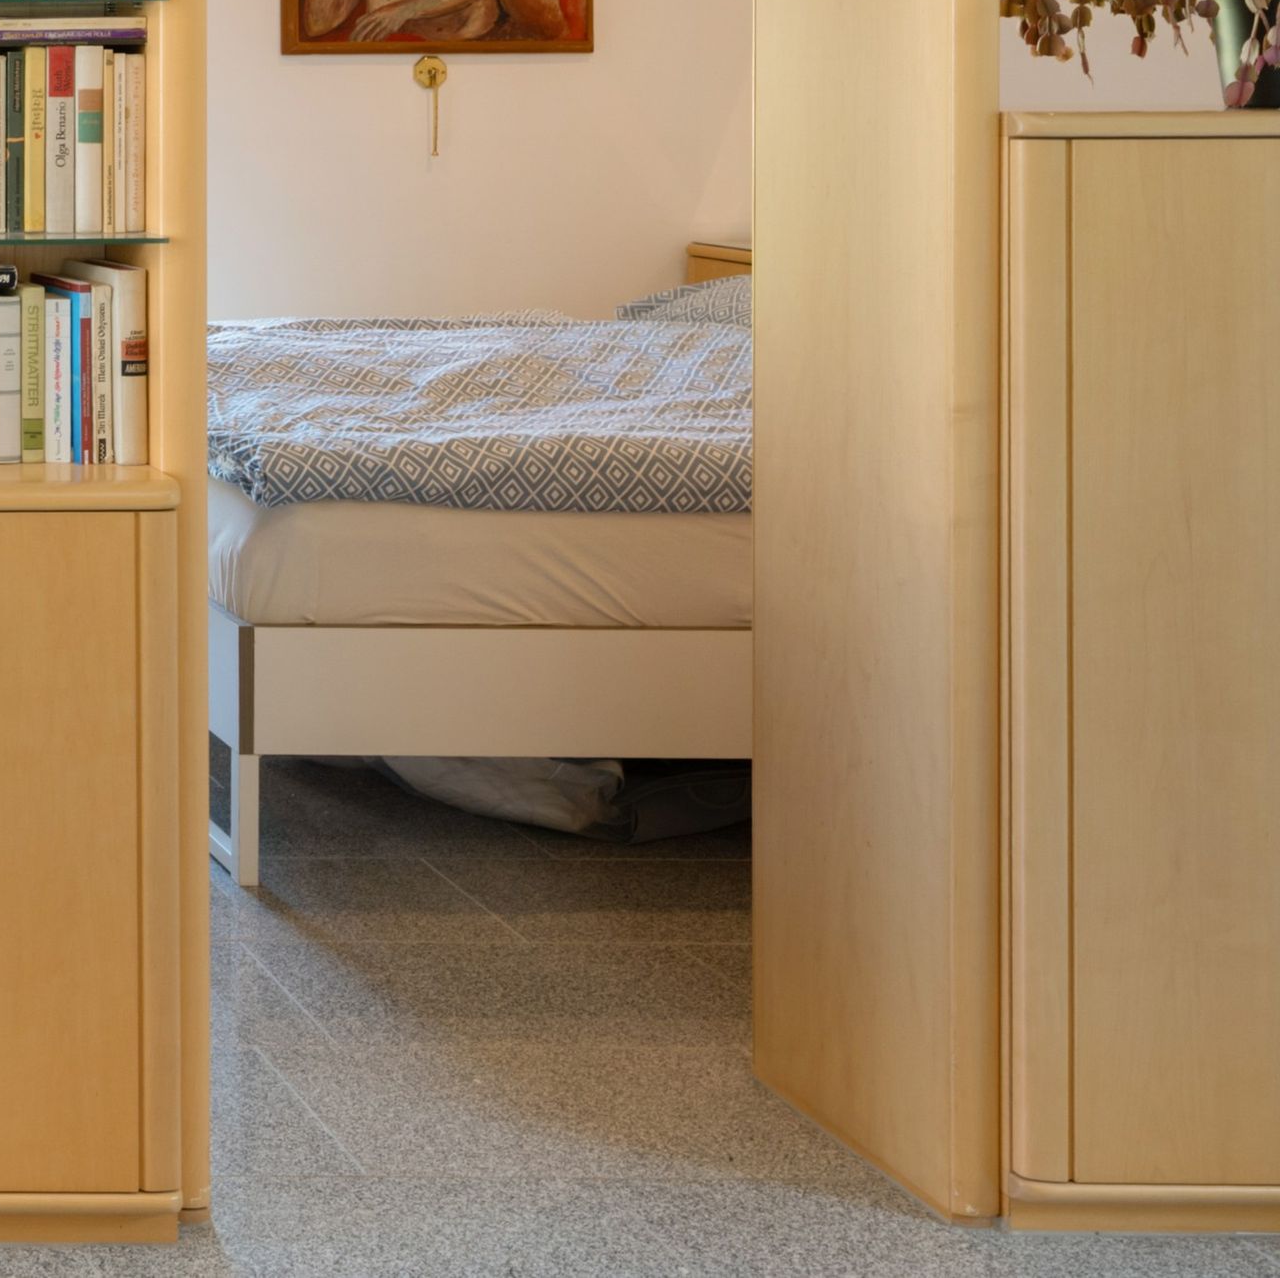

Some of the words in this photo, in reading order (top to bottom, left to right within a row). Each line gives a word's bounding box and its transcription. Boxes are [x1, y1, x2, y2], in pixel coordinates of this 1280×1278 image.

[54, 70, 64, 92] Ruth
[55, 102, 66, 140] Benario
[55, 143, 69, 168] Olga
[97, 302, 108, 337] Odysseus
[27, 305, 39, 406] STRITTMATTER
[97, 338, 106, 361] Onkel
[97, 361, 106, 383] Mein
[97, 393, 106, 420] Marek
